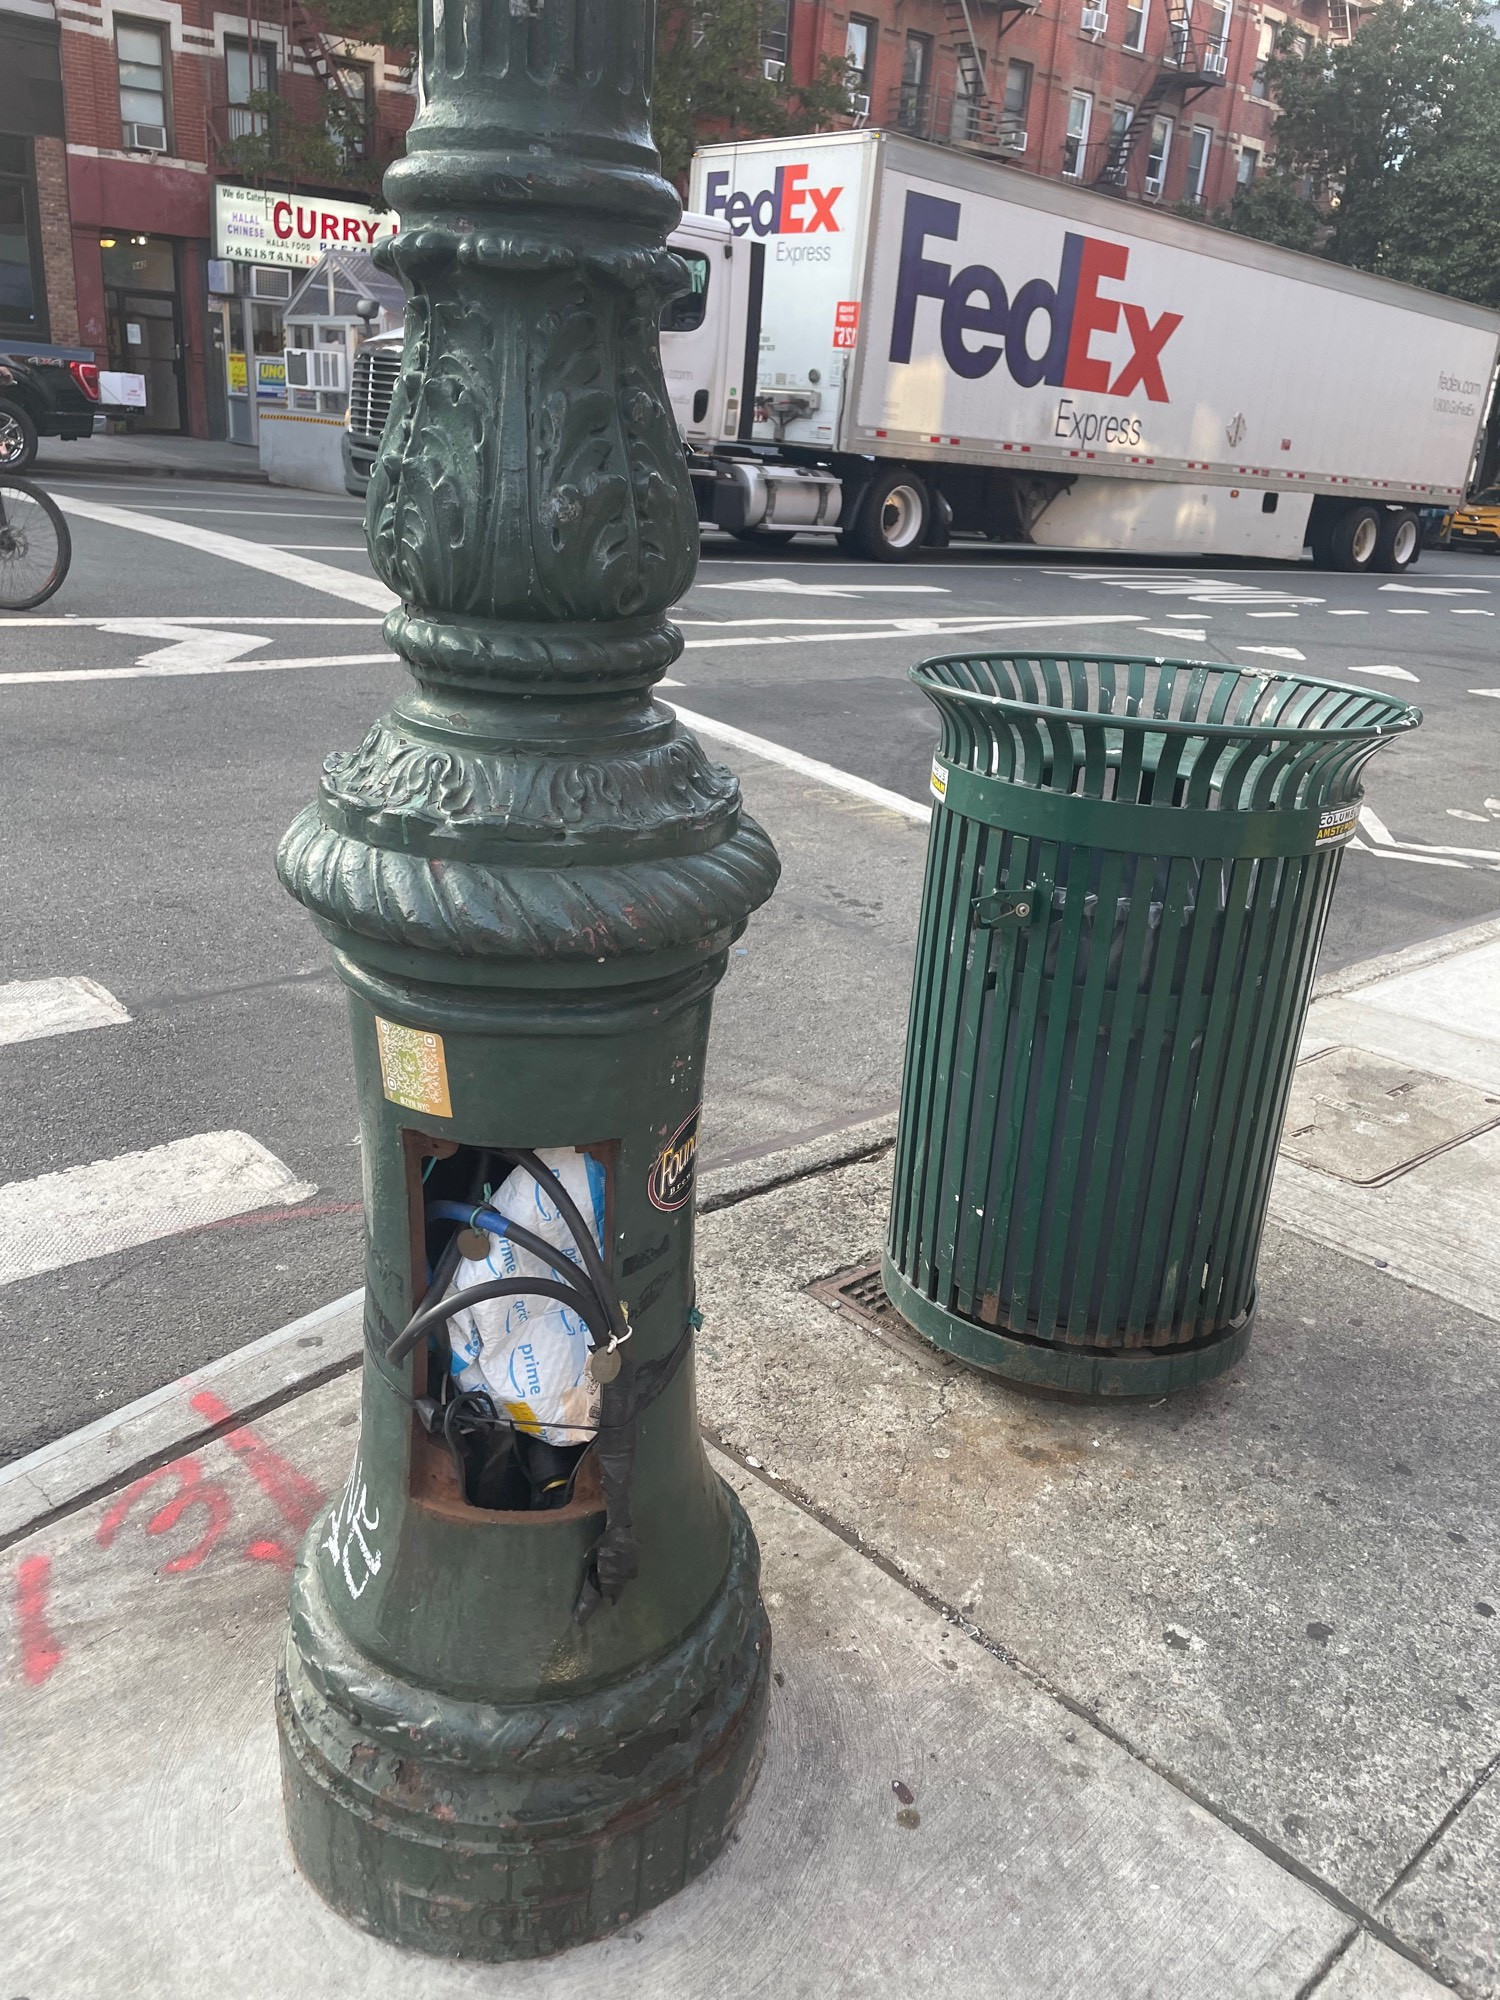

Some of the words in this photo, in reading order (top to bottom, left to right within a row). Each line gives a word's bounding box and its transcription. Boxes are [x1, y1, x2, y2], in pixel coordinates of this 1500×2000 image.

[222, 188, 234, 198] We
[236, 190, 244, 200] do
[706, 164, 845, 236] FedEx
[227, 224, 265, 238] CHINESE
[232, 212, 260, 225] HALAL
[273, 201, 380, 243] CURRY
[266, 238, 289, 248] HALAL
[292, 241, 311, 251] FOOD
[776, 241, 831, 266] Express
[889, 189, 1184, 404] FedEx
[1054, 398, 1142, 448] Express
[499, 1236, 517, 1274] rime
[518, 1342, 541, 1396] prime
